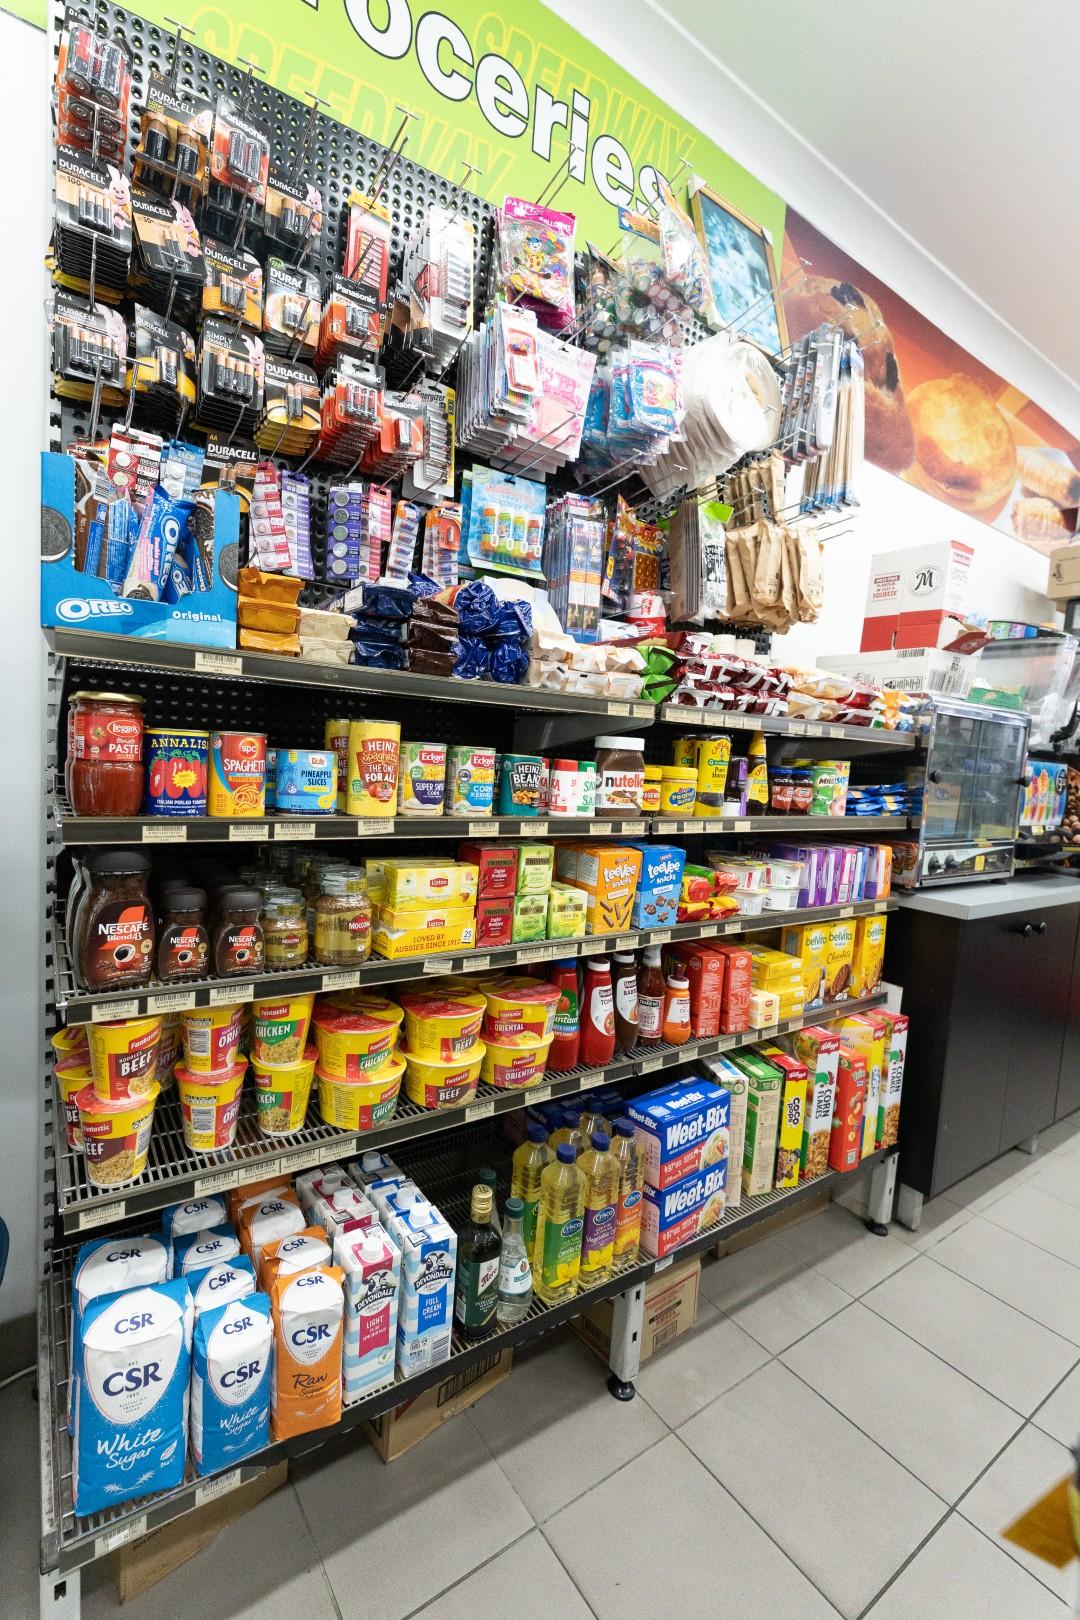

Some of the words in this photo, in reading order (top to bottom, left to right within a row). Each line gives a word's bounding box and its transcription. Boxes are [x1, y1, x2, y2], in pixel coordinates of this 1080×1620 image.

[149, 87, 197, 116] DURACELL
[59, 158, 105, 185] DURACELL
[269, 176, 304, 199] DURACELL
[132, 199, 172, 218] DURACELL
[204, 246, 248, 272] DURACELL
[335, 283, 376, 305] Panasonic
[265, 363, 315, 384] DURACELL
[207, 443, 257, 461] DURACELL
[57, 599, 131, 621] OREO
[172, 610, 221, 622] Original
[109, 743, 139, 754] PASTE
[151, 738, 209, 750] ANNALIS
[241, 744, 257, 755] spc
[368, 741, 397, 752] HEINZ
[301, 770, 332, 778] PINEAPPLE
[369, 764, 381, 773] THE
[308, 778, 326, 786] SLICES
[365, 773, 382, 782] FOR
[383, 773, 396, 783] ALL
[107, 934, 132, 942] Blend
[413, 934, 436, 944] LOVED
[464, 930, 472, 938] 25
[394, 943, 424, 954] AUSSIES
[425, 940, 447, 950] SINCE
[495, 1023, 524, 1031] ORIENTAL
[455, 1038, 473, 1051] BEEF
[121, 1049, 153, 1077] BEEF
[360, 1051, 389, 1070] CHICKEN
[505, 1067, 535, 1081] ORIENTAL
[893, 1065, 903, 1092] CORN
[439, 1088, 460, 1101] BEEF
[665, 1091, 705, 1110] Weet-Bix
[822, 1088, 832, 1118] CORN
[815, 1089, 823, 1120] FLAKES
[628, 1106, 657, 1131] Weet-Bix
[666, 1103, 728, 1150] Weet-Bix
[664, 1169, 726, 1218] Weet-Bix
[184, 1201, 209, 1214] CSR
[261, 1203, 285, 1216] CSR
[595, 1208, 614, 1223] Crisco
[196, 1240, 223, 1254] CSR
[282, 1238, 308, 1252] CSR
[107, 1249, 142, 1263] CSR
[209, 1271, 237, 1290] CSR
[296, 1275, 325, 1287] CSR
[416, 1270, 451, 1289] DEVONDALE
[356, 1287, 394, 1311] DEVONDALE
[425, 1296, 439, 1306] FULL
[422, 1303, 442, 1317] CREAM
[114, 1312, 155, 1335] CSR
[223, 1316, 254, 1335] CSR
[366, 1316, 384, 1330] LIGHT
[291, 1323, 332, 1347] CSR
[102, 1361, 163, 1397] CSR
[220, 1360, 262, 1388] CSR
[292, 1372, 328, 1390] Raw
[219, 1405, 259, 1430] White
[225, 1419, 252, 1436] Sugar
[97, 1426, 166, 1455] White
[105, 1445, 156, 1471] Sugar
